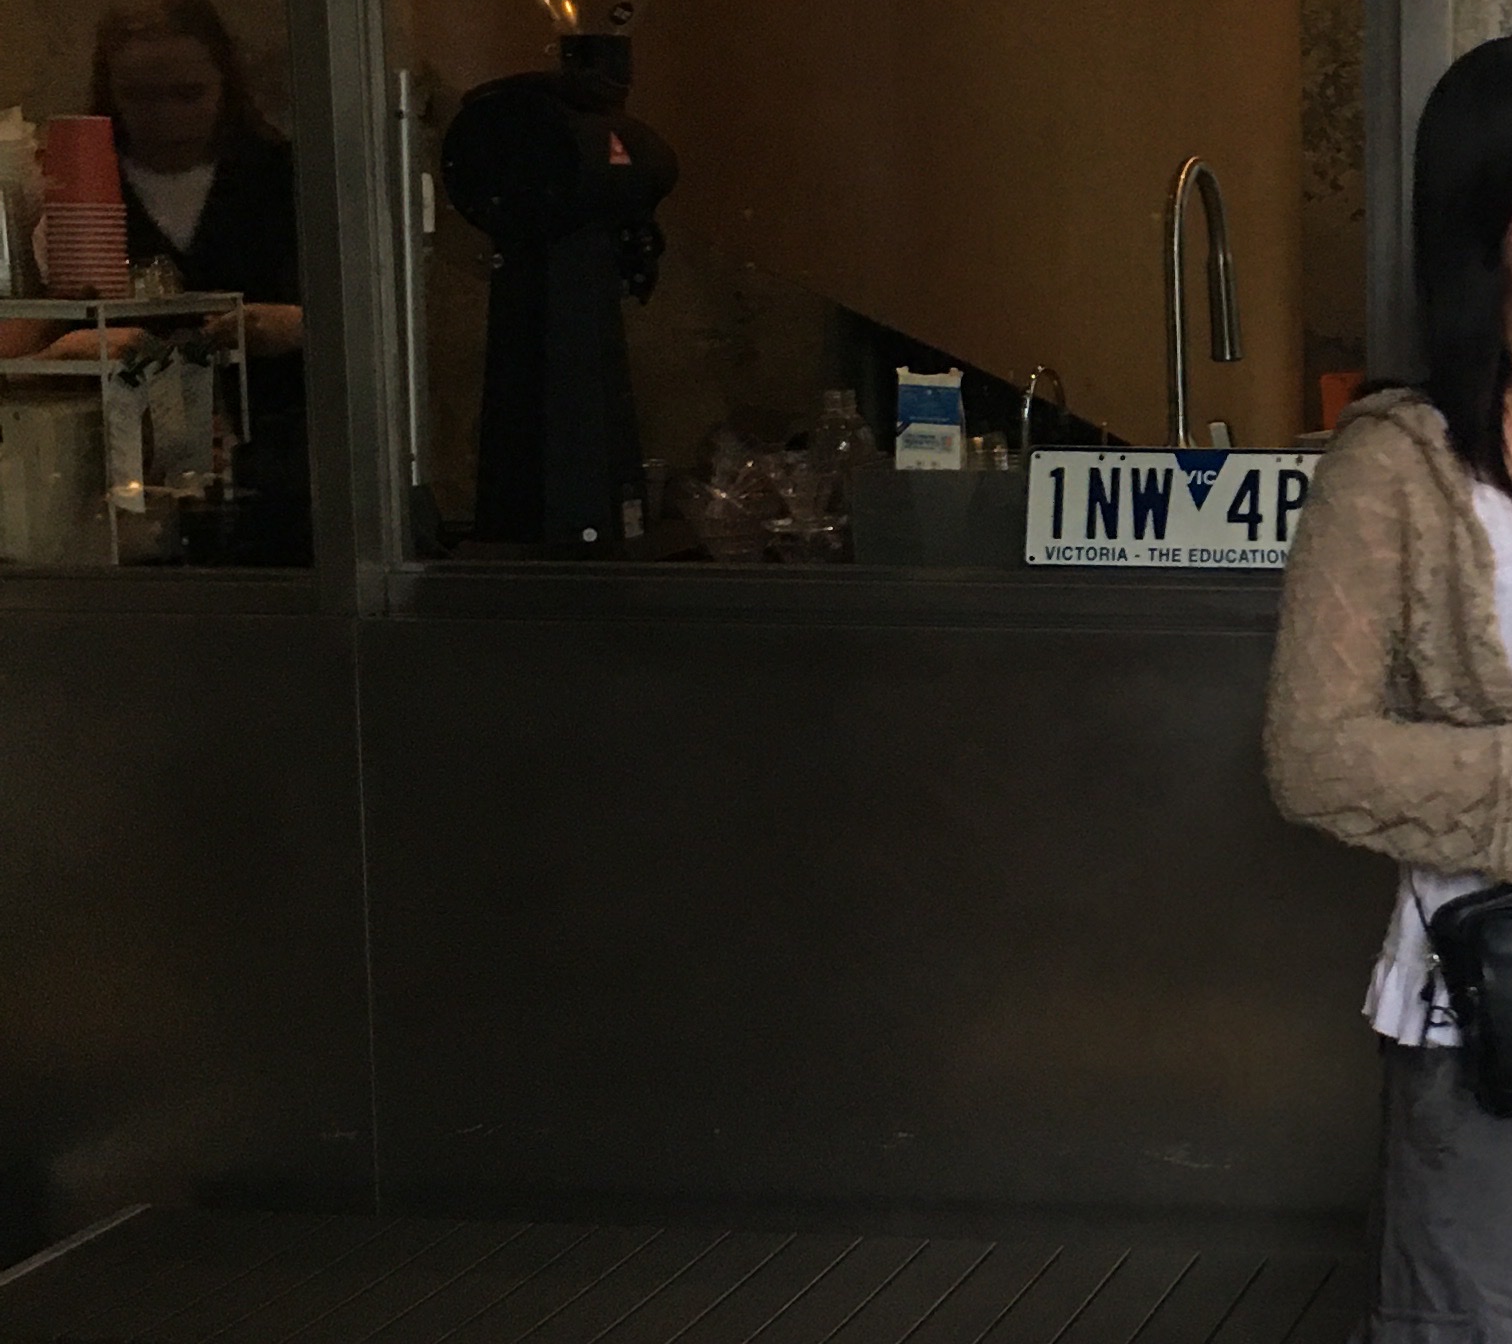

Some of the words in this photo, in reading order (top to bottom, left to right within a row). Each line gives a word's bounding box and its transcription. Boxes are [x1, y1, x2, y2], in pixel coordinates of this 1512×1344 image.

[1050, 467, 1174, 540] 1NW
[1045, 546, 1128, 562] VICTORIA
[1148, 547, 1182, 563] THE
